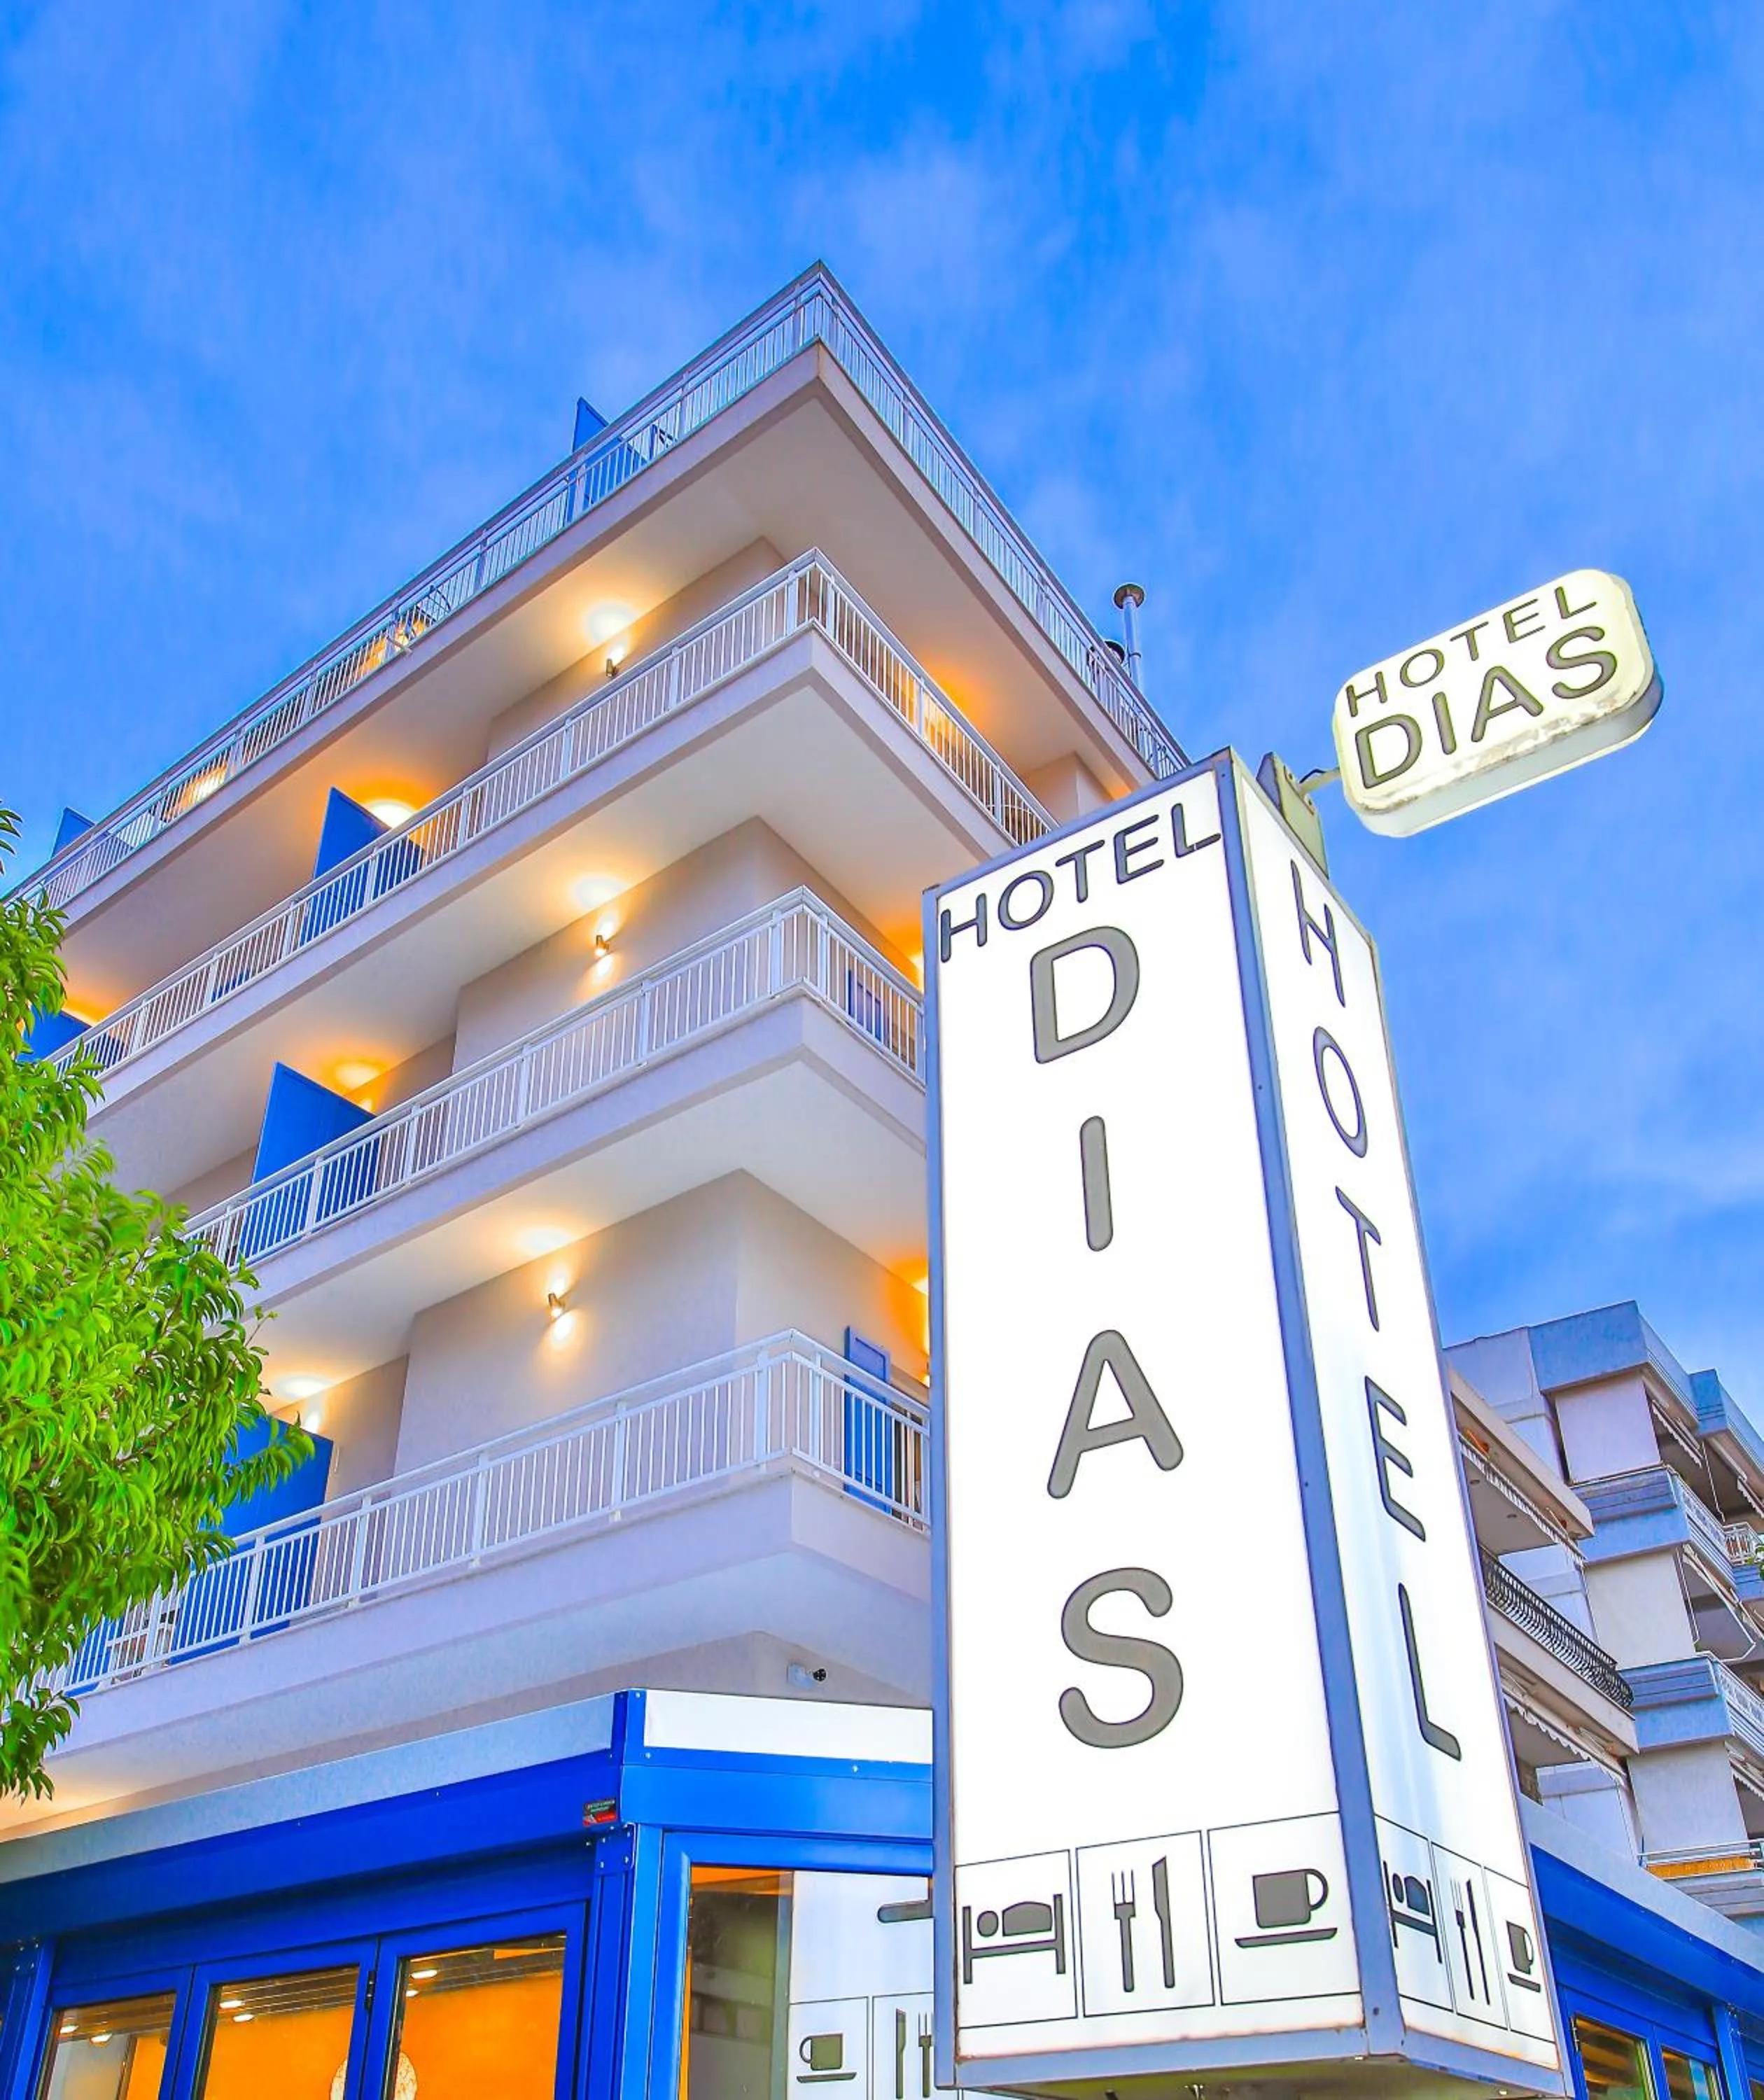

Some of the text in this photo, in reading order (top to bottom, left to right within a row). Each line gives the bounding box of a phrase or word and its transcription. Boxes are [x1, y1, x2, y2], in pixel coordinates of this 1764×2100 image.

[1345, 587, 1597, 718] HOTEL
[1355, 626, 1617, 788] DIAS
[941, 803, 1221, 962] HOTEL
[1030, 926, 1184, 1749] DIAS
[1290, 860, 1462, 1761] HOTEL
